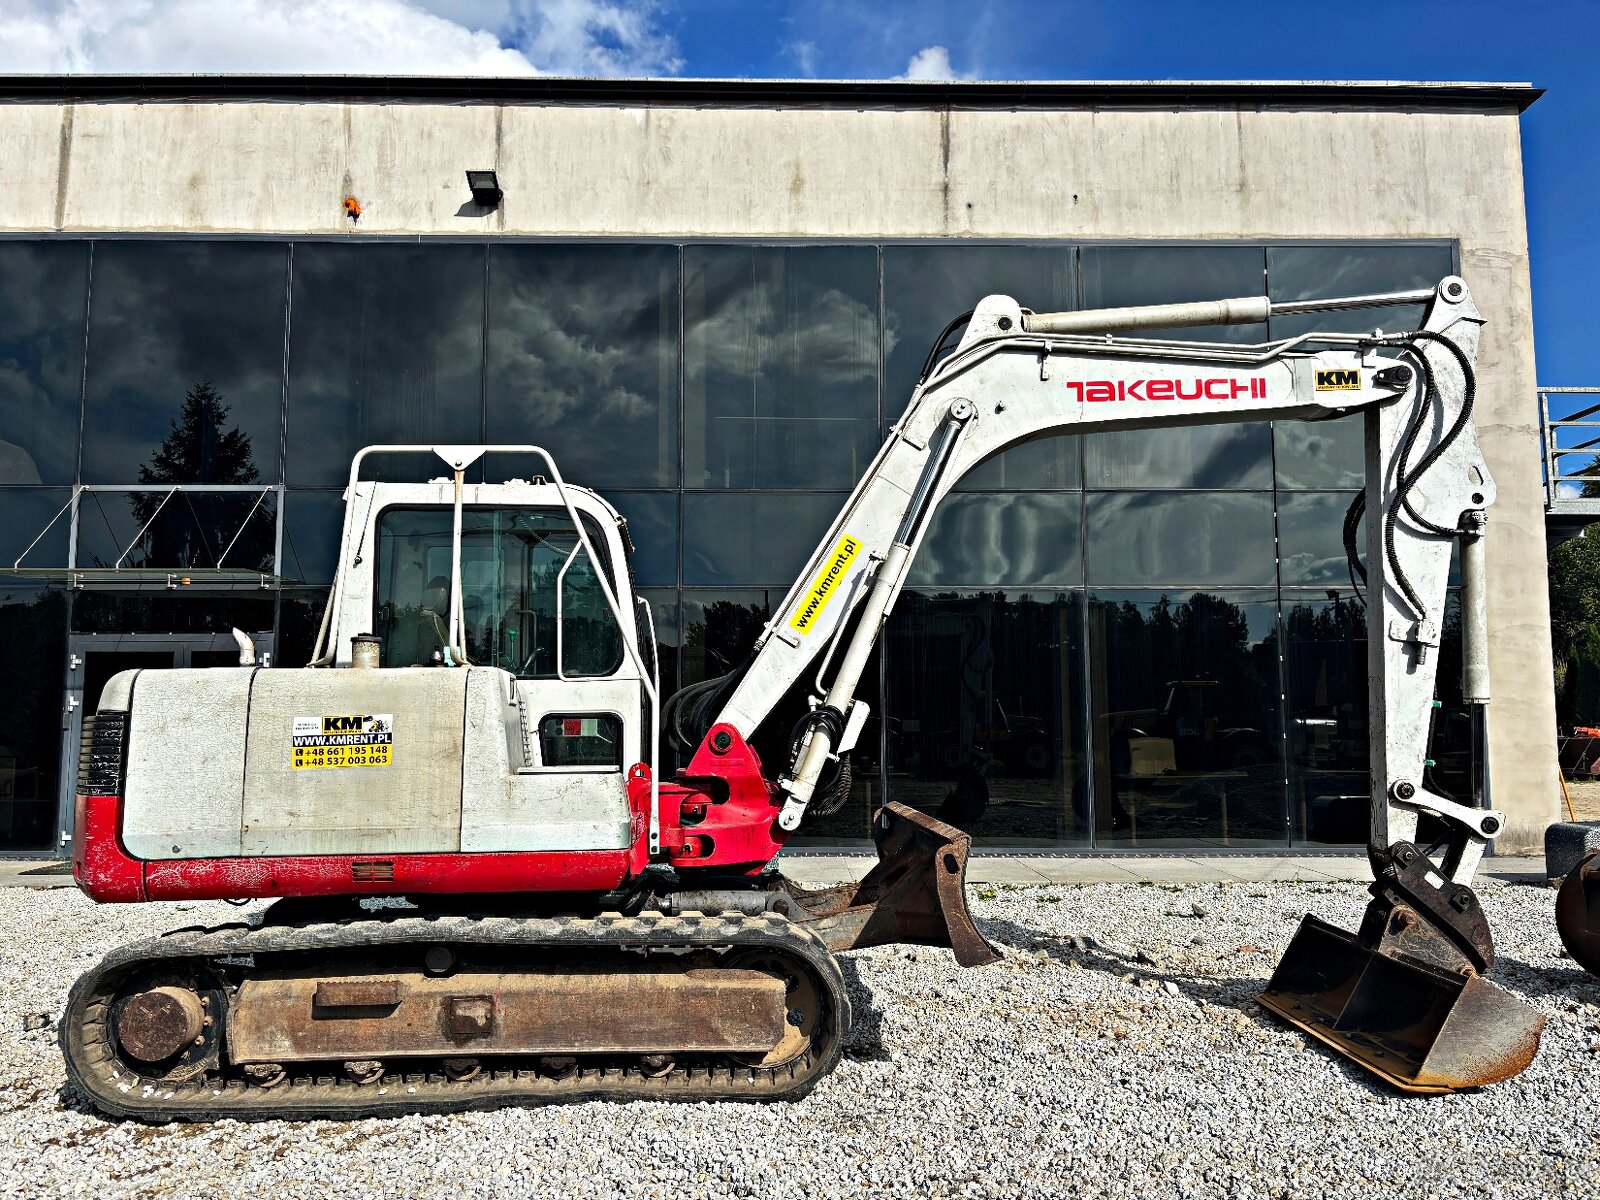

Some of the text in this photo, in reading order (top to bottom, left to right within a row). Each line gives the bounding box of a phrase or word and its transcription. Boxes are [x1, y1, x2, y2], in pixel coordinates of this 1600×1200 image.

[1318, 371, 1358, 385] KM
[797, 539, 856, 628] www.kmrent.pl
[324, 717, 362, 730] KM
[294, 734, 391, 746] WWW.KMRENT.PL
[305, 745, 388, 756] +48 661 195 148
[305, 755, 387, 766] +48 537 003 063
